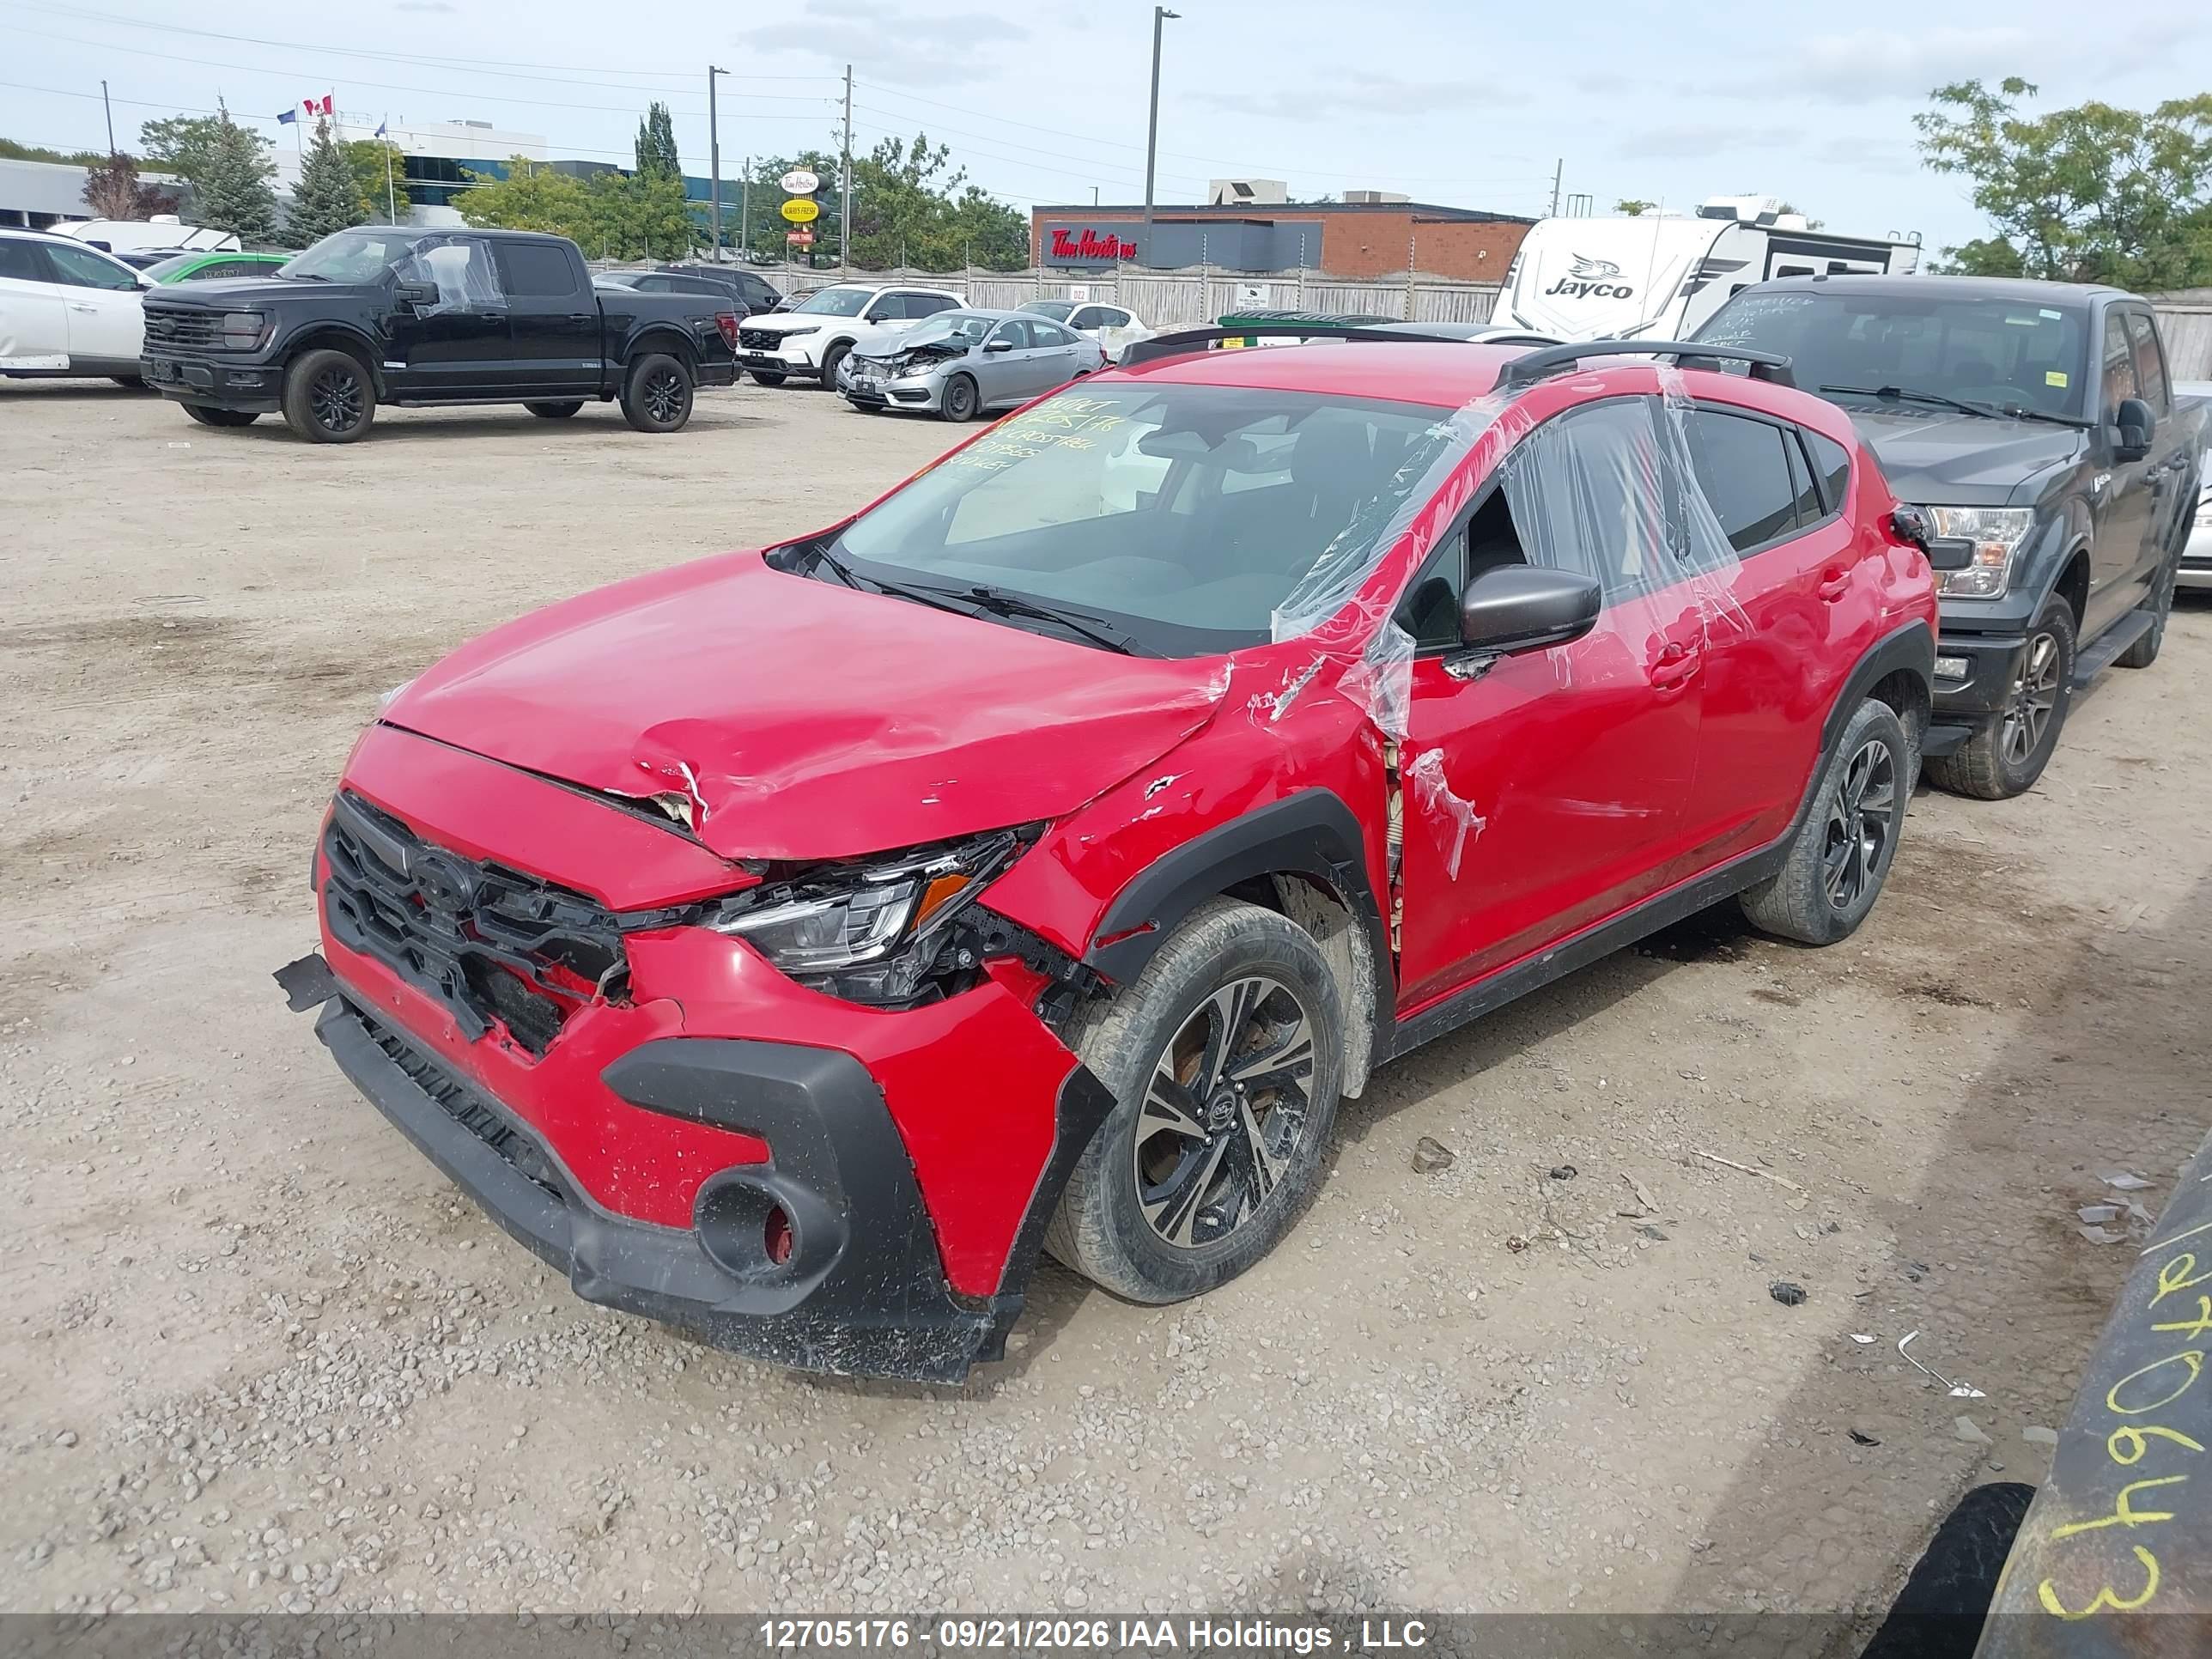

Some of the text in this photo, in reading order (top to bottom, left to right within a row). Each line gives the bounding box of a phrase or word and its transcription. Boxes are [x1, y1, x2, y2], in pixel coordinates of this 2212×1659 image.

[784, 175, 816, 188] Tim Hortons
[1051, 228, 1138, 258] Tim Hortons
[1546, 277, 1633, 299] Jayco
